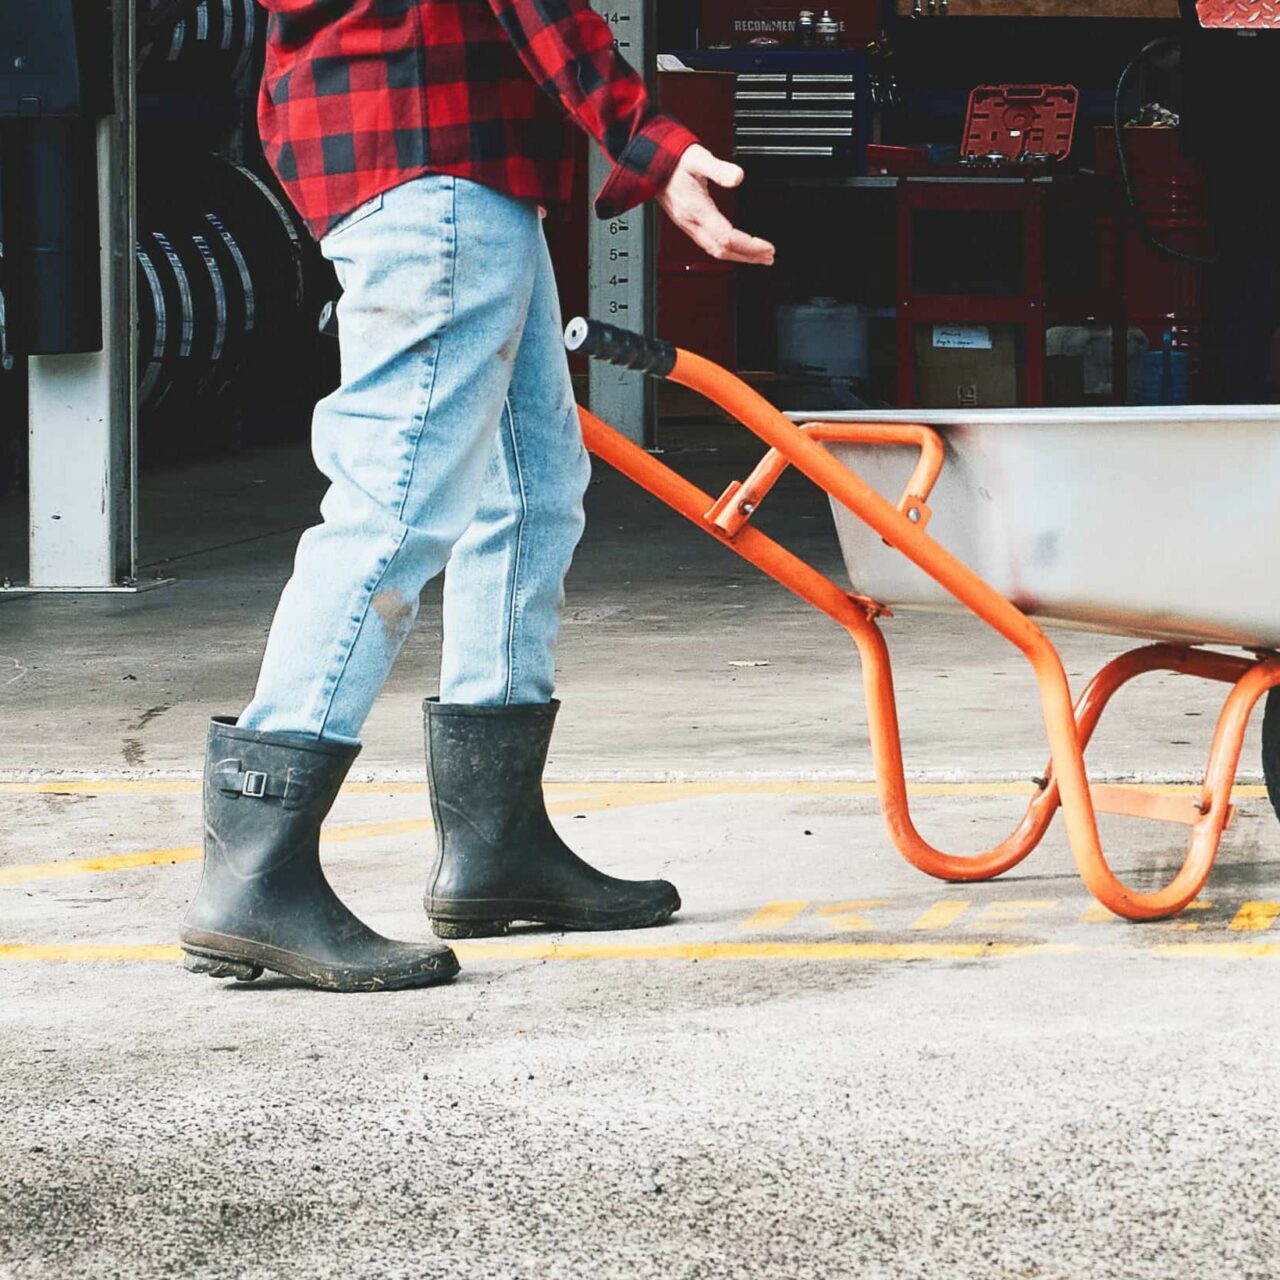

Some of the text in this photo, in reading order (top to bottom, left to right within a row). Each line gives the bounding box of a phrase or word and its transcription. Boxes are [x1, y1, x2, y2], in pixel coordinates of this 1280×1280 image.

[604, 12, 619, 25] 14
[735, 20, 796, 32] RECOMMEN
[609, 222, 618, 235] 6
[609, 249, 618, 261] 5
[609, 275, 618, 287] 4
[609, 301, 618, 313] 3
